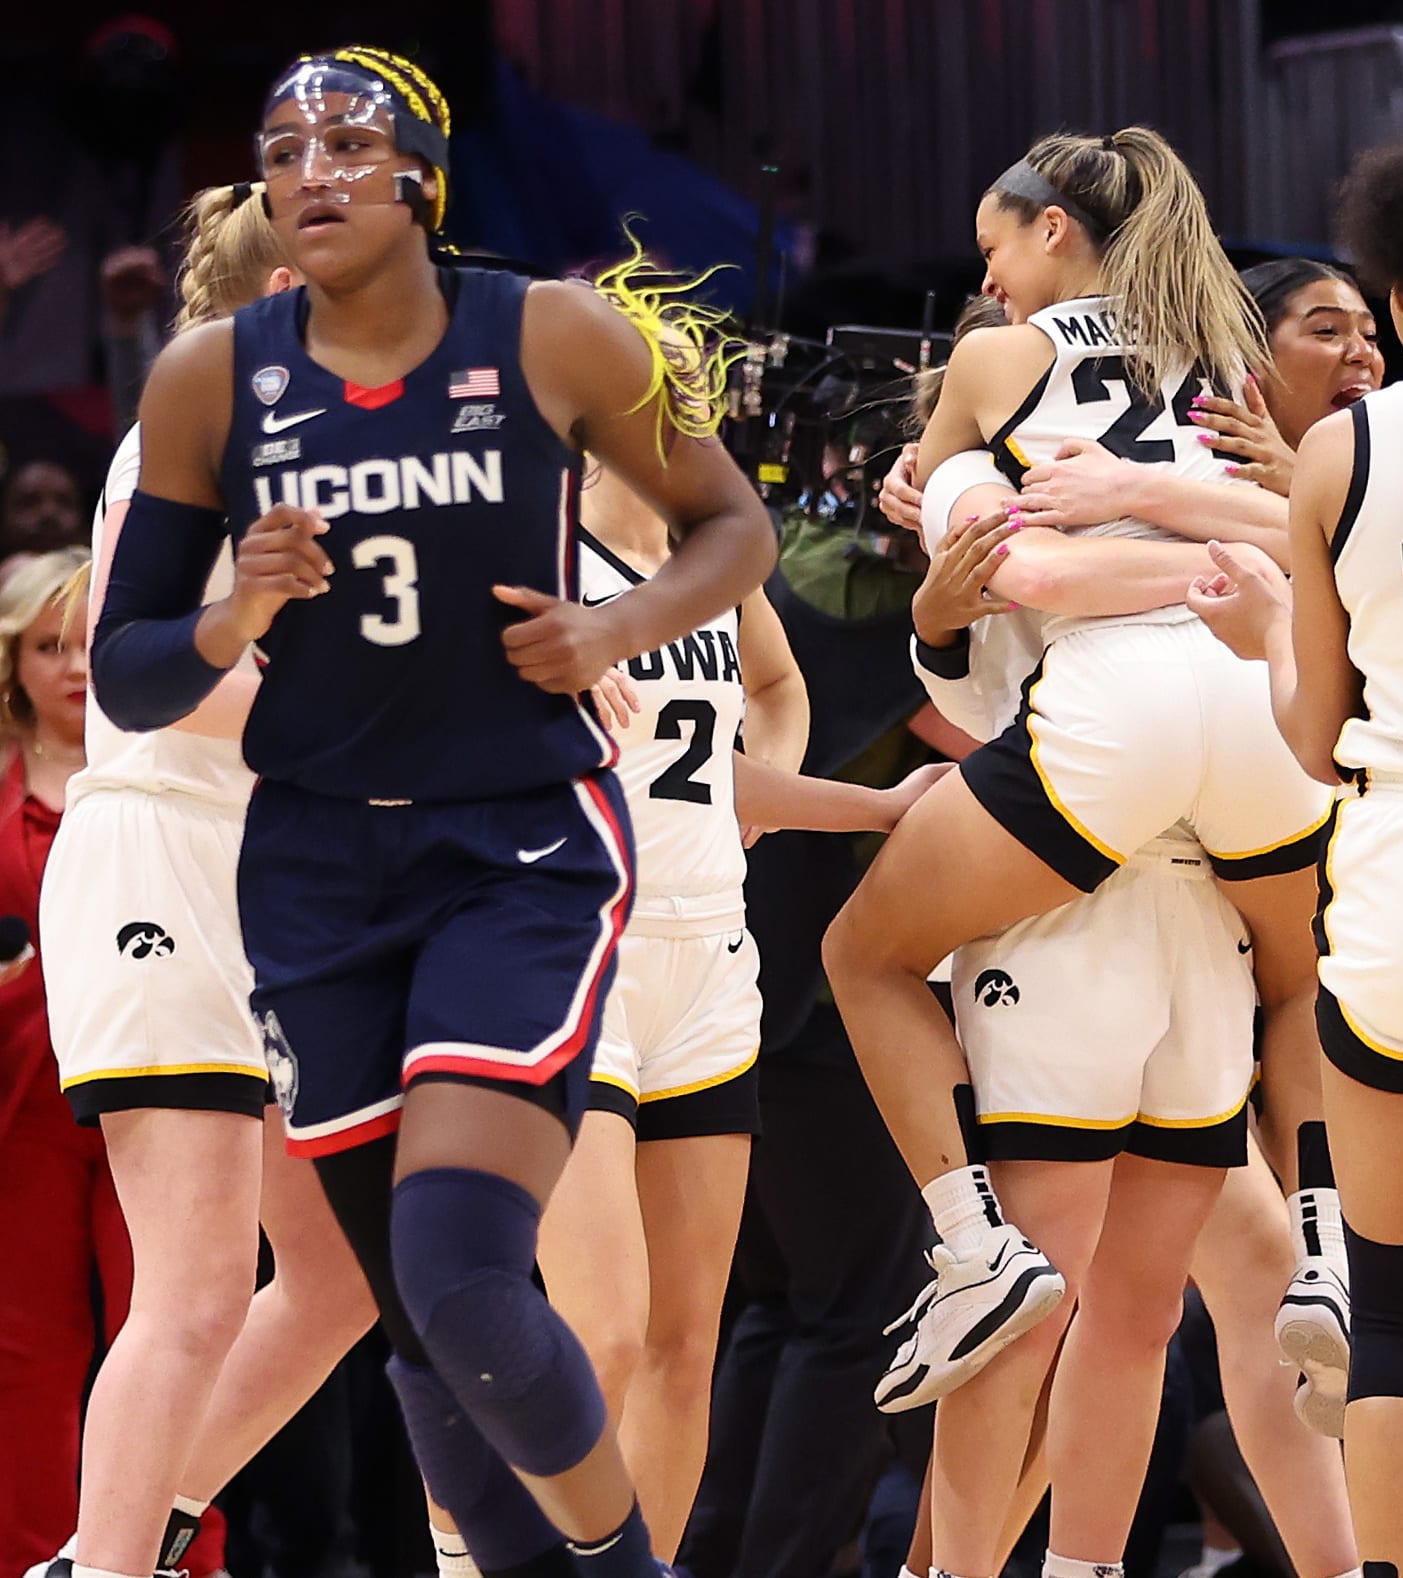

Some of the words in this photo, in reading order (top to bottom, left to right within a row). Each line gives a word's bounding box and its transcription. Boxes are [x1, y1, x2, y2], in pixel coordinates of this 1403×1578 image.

[253, 449, 504, 520] UCONN
[351, 535, 421, 647] 3
[614, 630, 743, 685] OWA
[649, 700, 717, 805] 2
